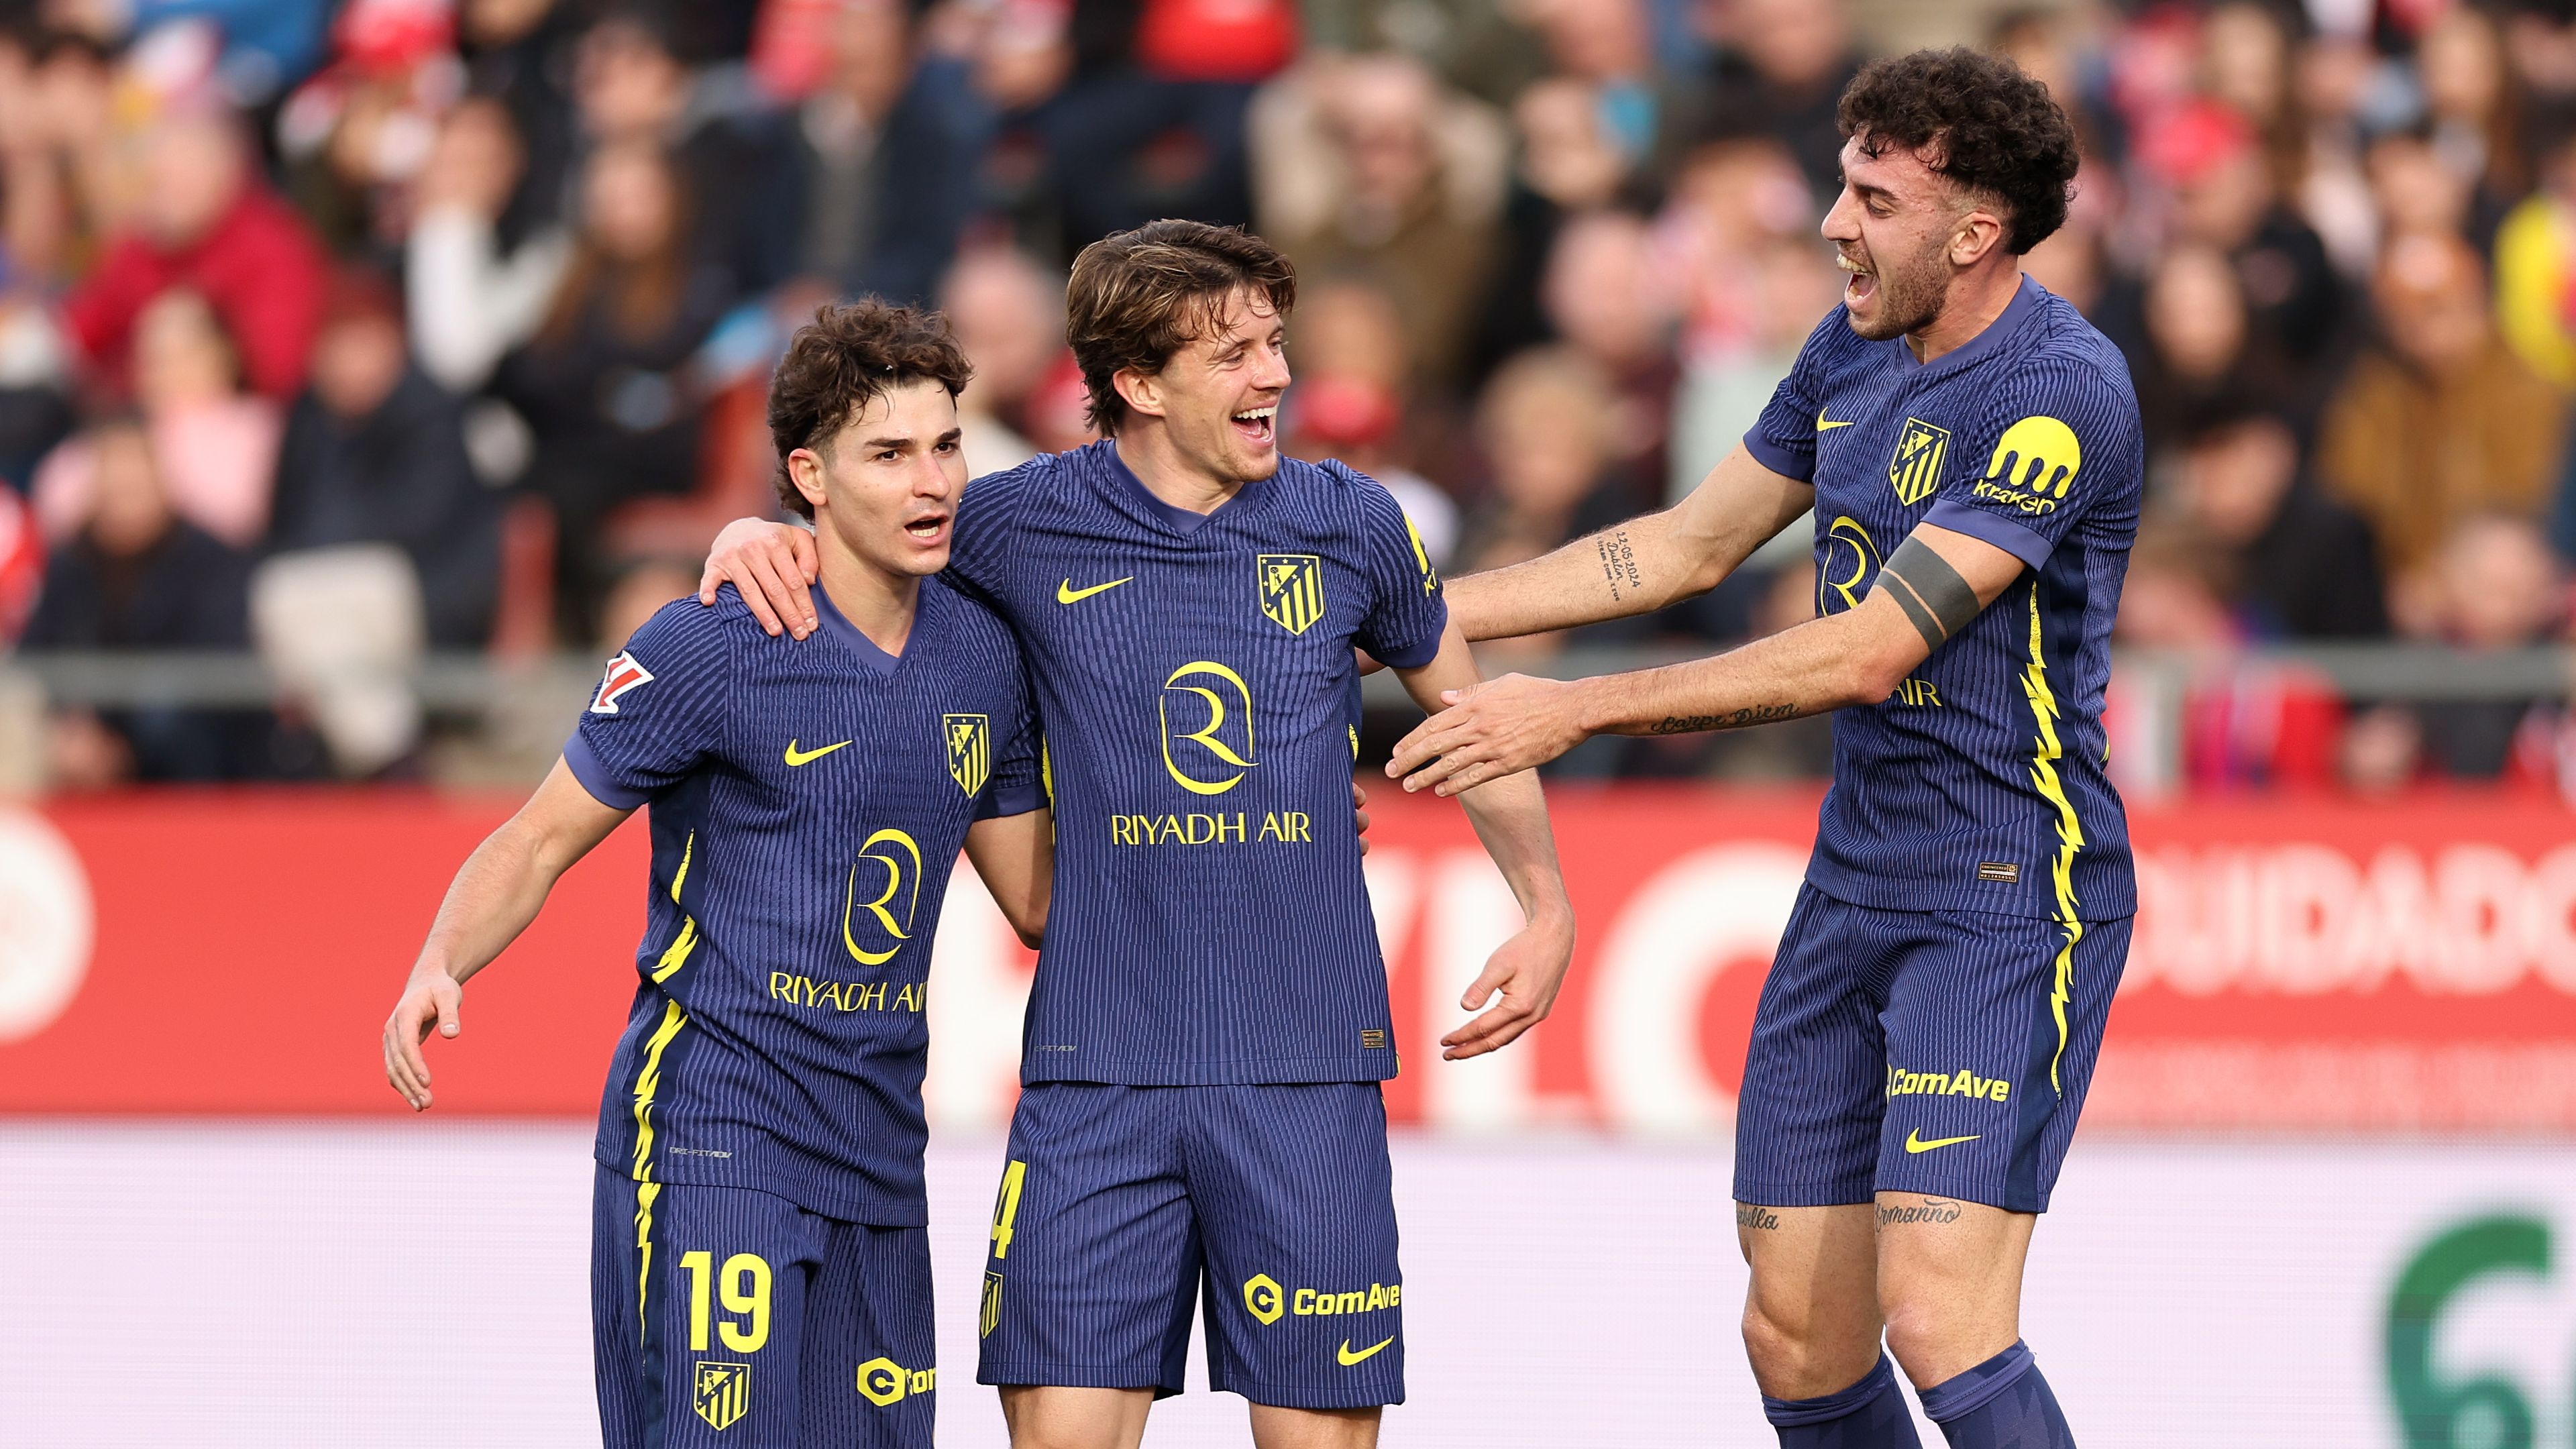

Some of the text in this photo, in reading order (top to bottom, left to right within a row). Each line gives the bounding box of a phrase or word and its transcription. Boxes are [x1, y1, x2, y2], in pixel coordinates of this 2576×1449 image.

[1973, 478, 2056, 516] kraken
[1606, 541, 1623, 581] Dublin
[1603, 563, 1613, 580] come
[1610, 582, 1620, 602] true
[1651, 702, 1800, 735] Carpe Diem
[1111, 811, 1312, 845] RIYADH AIR
[770, 971, 888, 1012] RIYADH
[1891, 1068, 2010, 1102] ComAve
[991, 1160, 1026, 1259] 4
[679, 1250, 771, 1354] 19
[1293, 1283, 1400, 1316] ComAve
